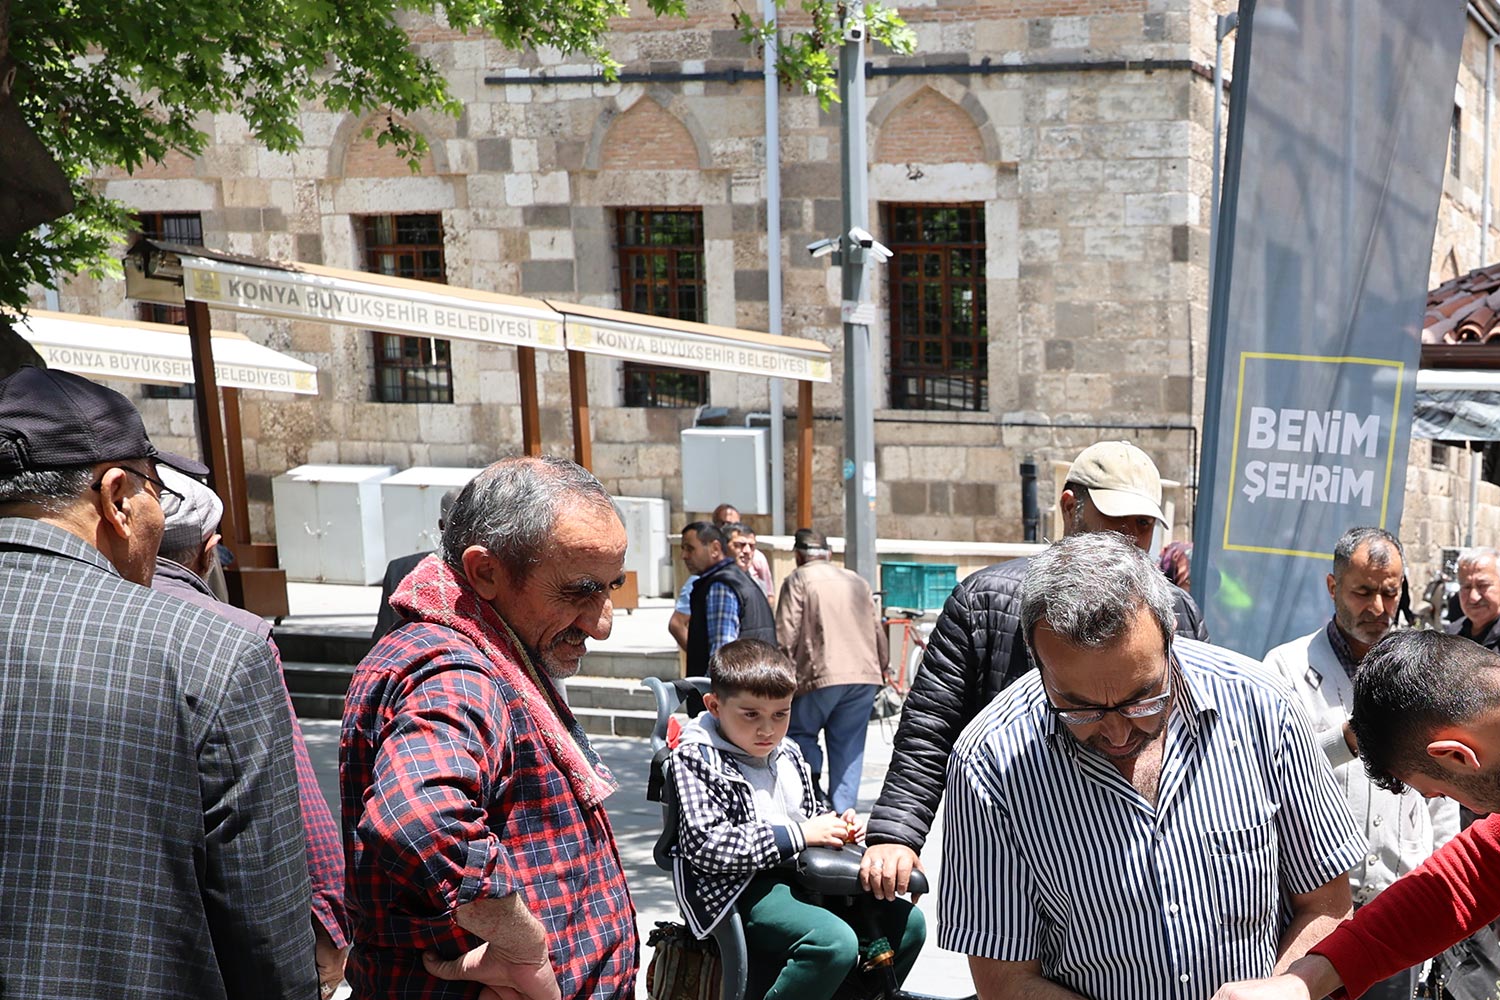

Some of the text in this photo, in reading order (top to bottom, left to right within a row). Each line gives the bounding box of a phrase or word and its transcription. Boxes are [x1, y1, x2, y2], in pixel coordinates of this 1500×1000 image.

[228, 279, 300, 306] KONYA
[306, 288, 428, 324] BÜYÜKŞEHİR
[434, 310, 532, 339] BELEDİYESİ
[596, 331, 646, 353] KONYA
[48, 348, 107, 368] KONYA
[109, 352, 193, 377] BÜYÜKŞEH
